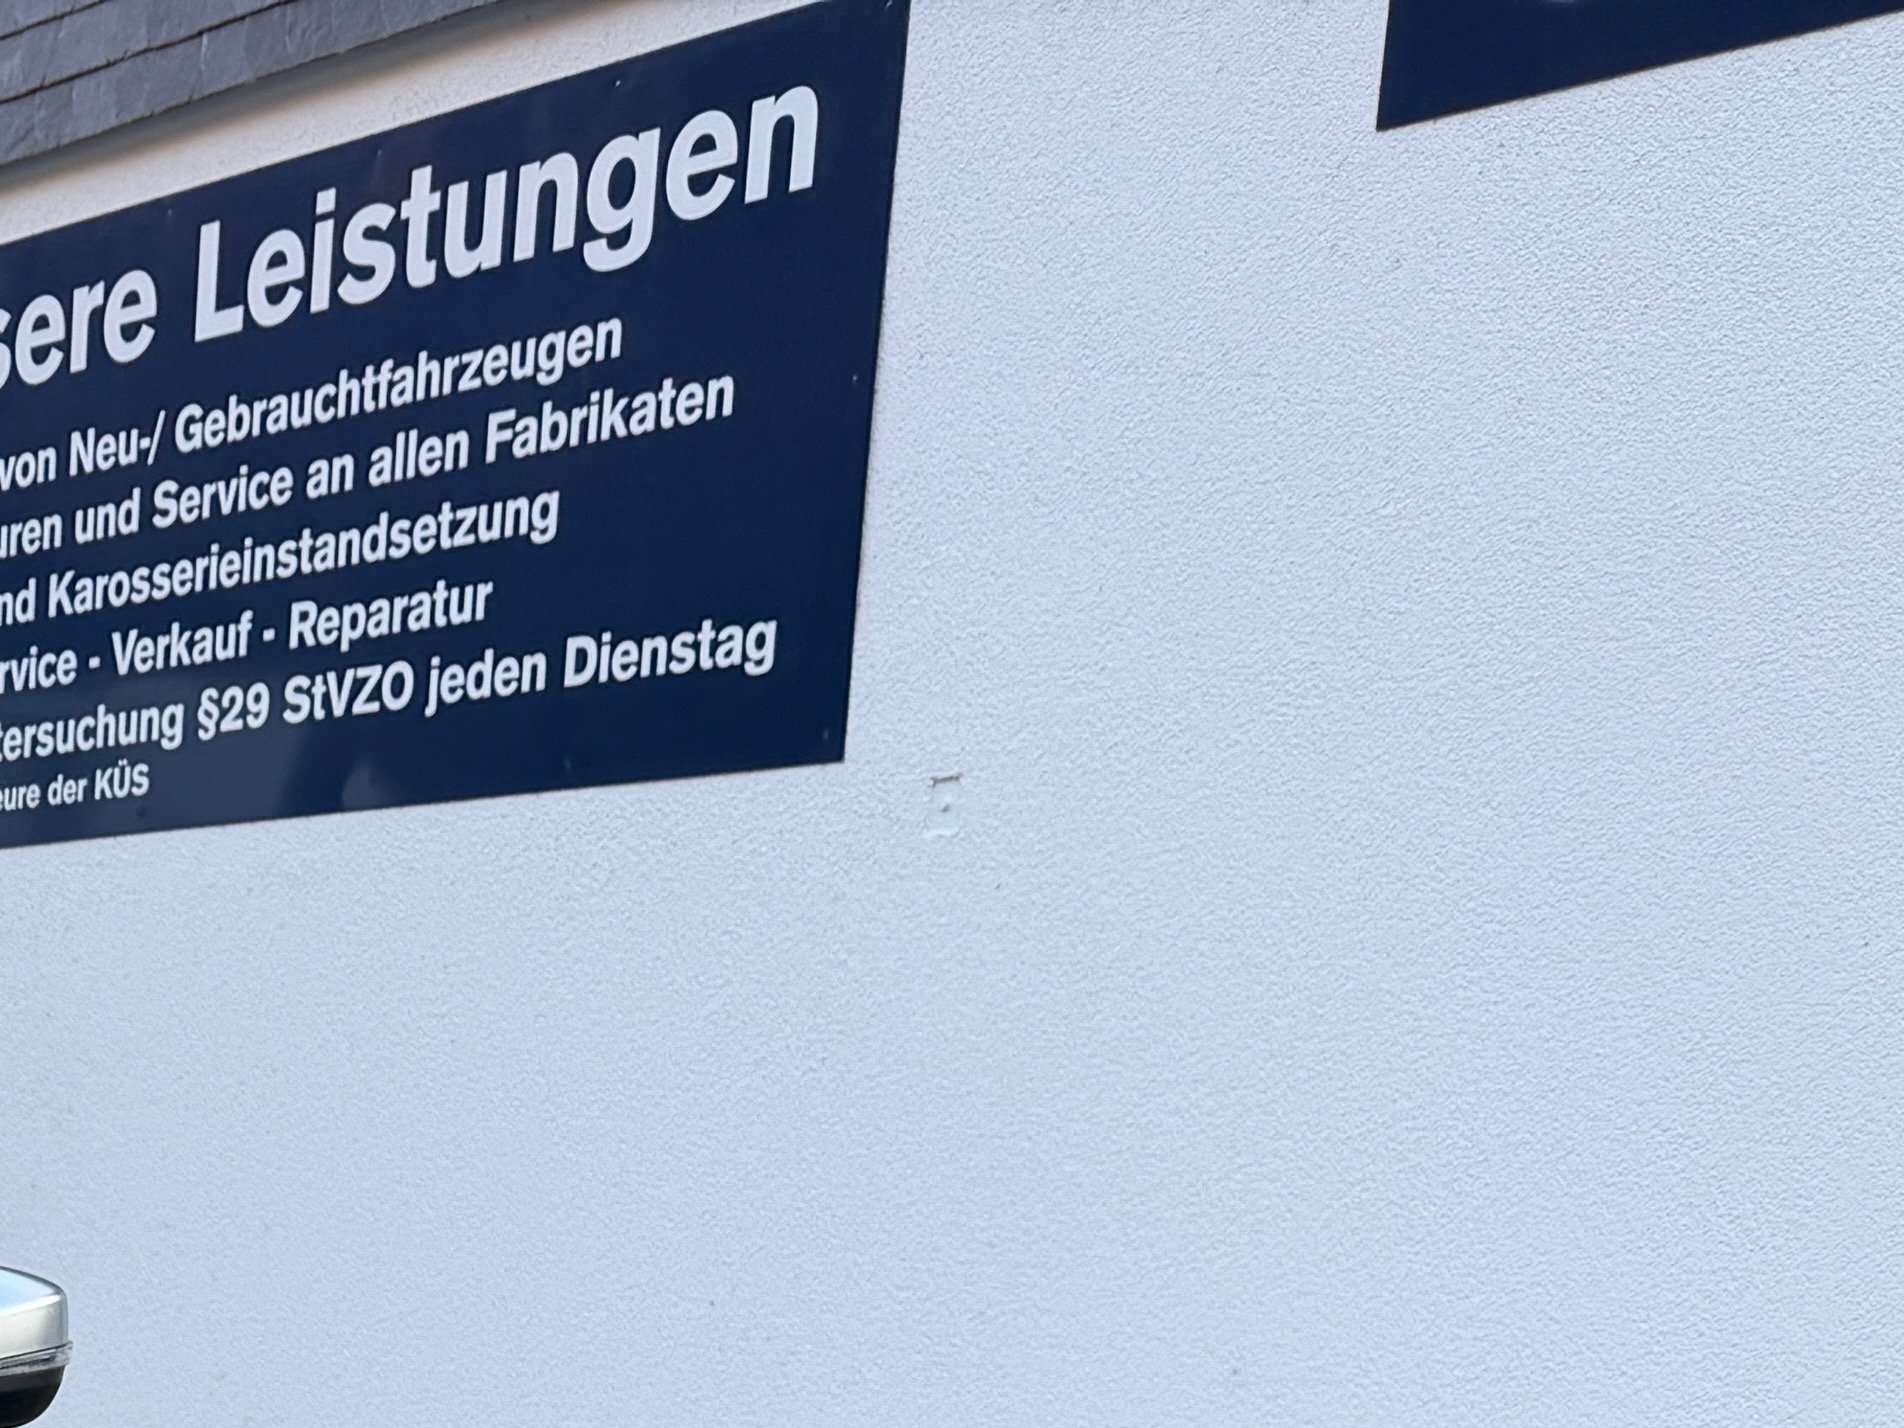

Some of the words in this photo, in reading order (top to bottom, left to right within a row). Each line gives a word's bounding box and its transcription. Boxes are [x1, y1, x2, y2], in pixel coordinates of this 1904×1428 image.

[193, 84, 820, 343] Leistungen
[69, 409, 167, 478] Neu-/
[174, 317, 623, 454] Gebrauchtfahrzeugen
[74, 486, 141, 544] und
[152, 464, 293, 528] Service
[305, 454, 354, 500] an
[368, 427, 469, 488] allen
[484, 374, 735, 465] Fabrikaten
[47, 490, 561, 618] Karosserieinstandsetzung
[111, 610, 253, 677] Verkauf
[287, 578, 494, 654] Reparatur
[195, 682, 271, 742] §29
[282, 660, 415, 724] StVZO
[424, 649, 547, 718] jeden
[562, 618, 778, 688] Dienstag
[47, 773, 88, 807] der
[94, 758, 151, 801] KÜS
